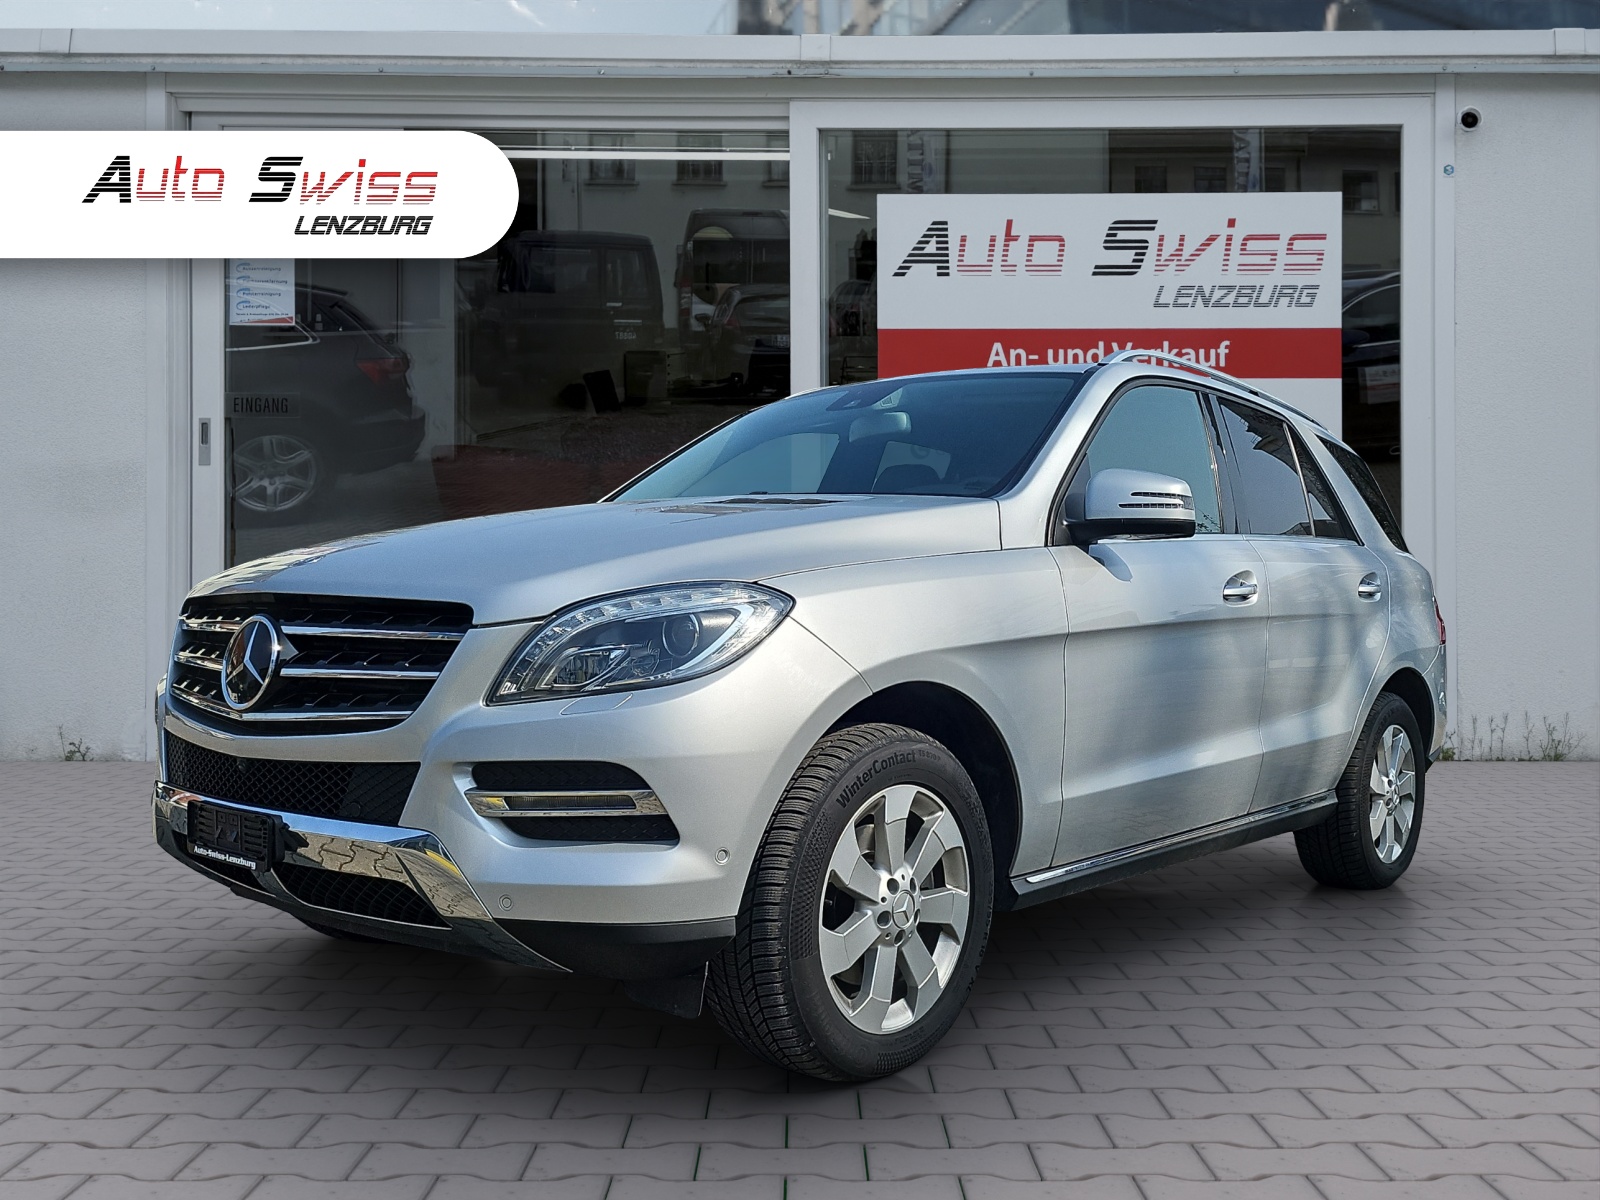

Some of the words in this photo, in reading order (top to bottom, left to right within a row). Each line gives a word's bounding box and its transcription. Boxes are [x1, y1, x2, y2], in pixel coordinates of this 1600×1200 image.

[892, 218, 1066, 277] Auto
[1091, 217, 1328, 276] Swiss
[1153, 284, 1321, 308] LENZBURG
[987, 342, 1039, 367] An-
[1047, 341, 1104, 365] und
[233, 397, 289, 413] EINGANG
[836, 750, 916, 808] WinterContact
[193, 845, 257, 871] Auto-Swiss-Lenzburg
